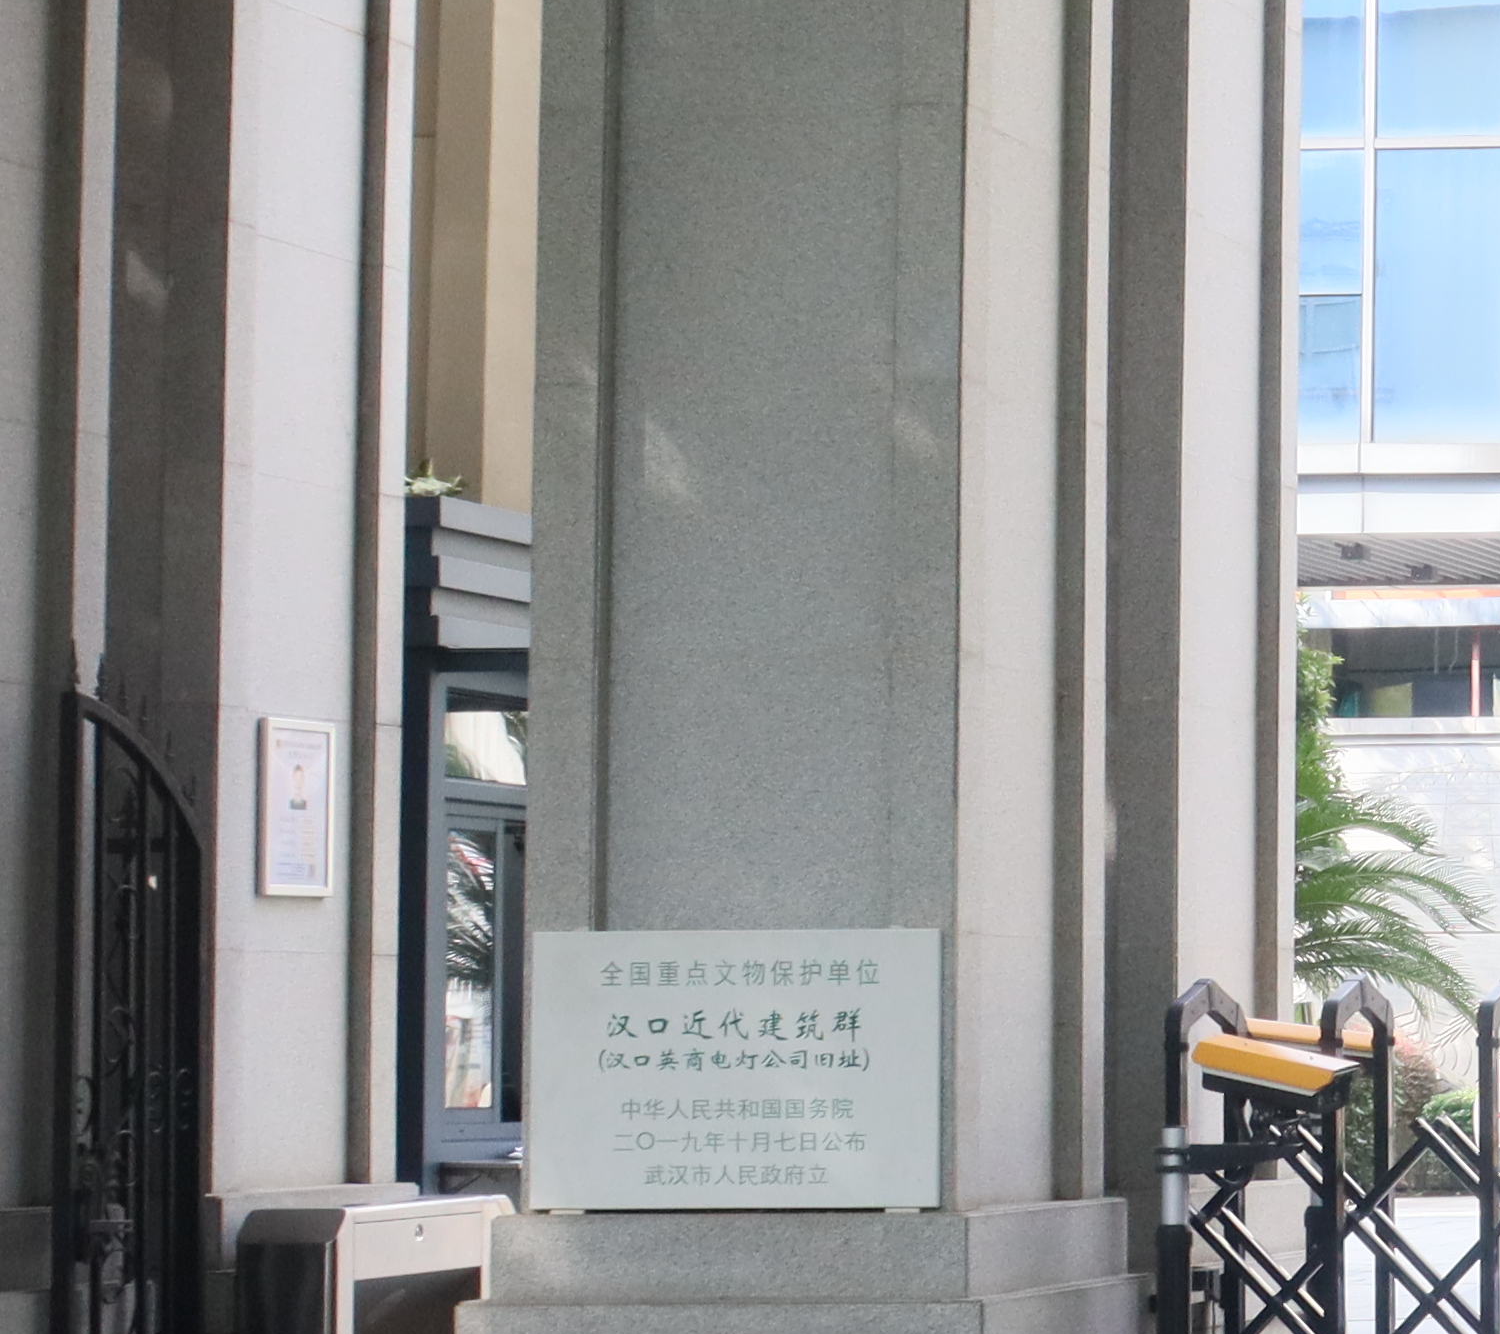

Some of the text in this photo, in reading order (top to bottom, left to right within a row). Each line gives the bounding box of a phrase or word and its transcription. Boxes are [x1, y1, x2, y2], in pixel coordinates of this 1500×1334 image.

[599, 959, 880, 988] 全国重点文物保护单位
[607, 1008, 862, 1043] 汉口近代建筑群
[620, 1098, 855, 1120] 中华人民共和国国务院
[644, 1164, 830, 1186] 武汉市人民政府立
